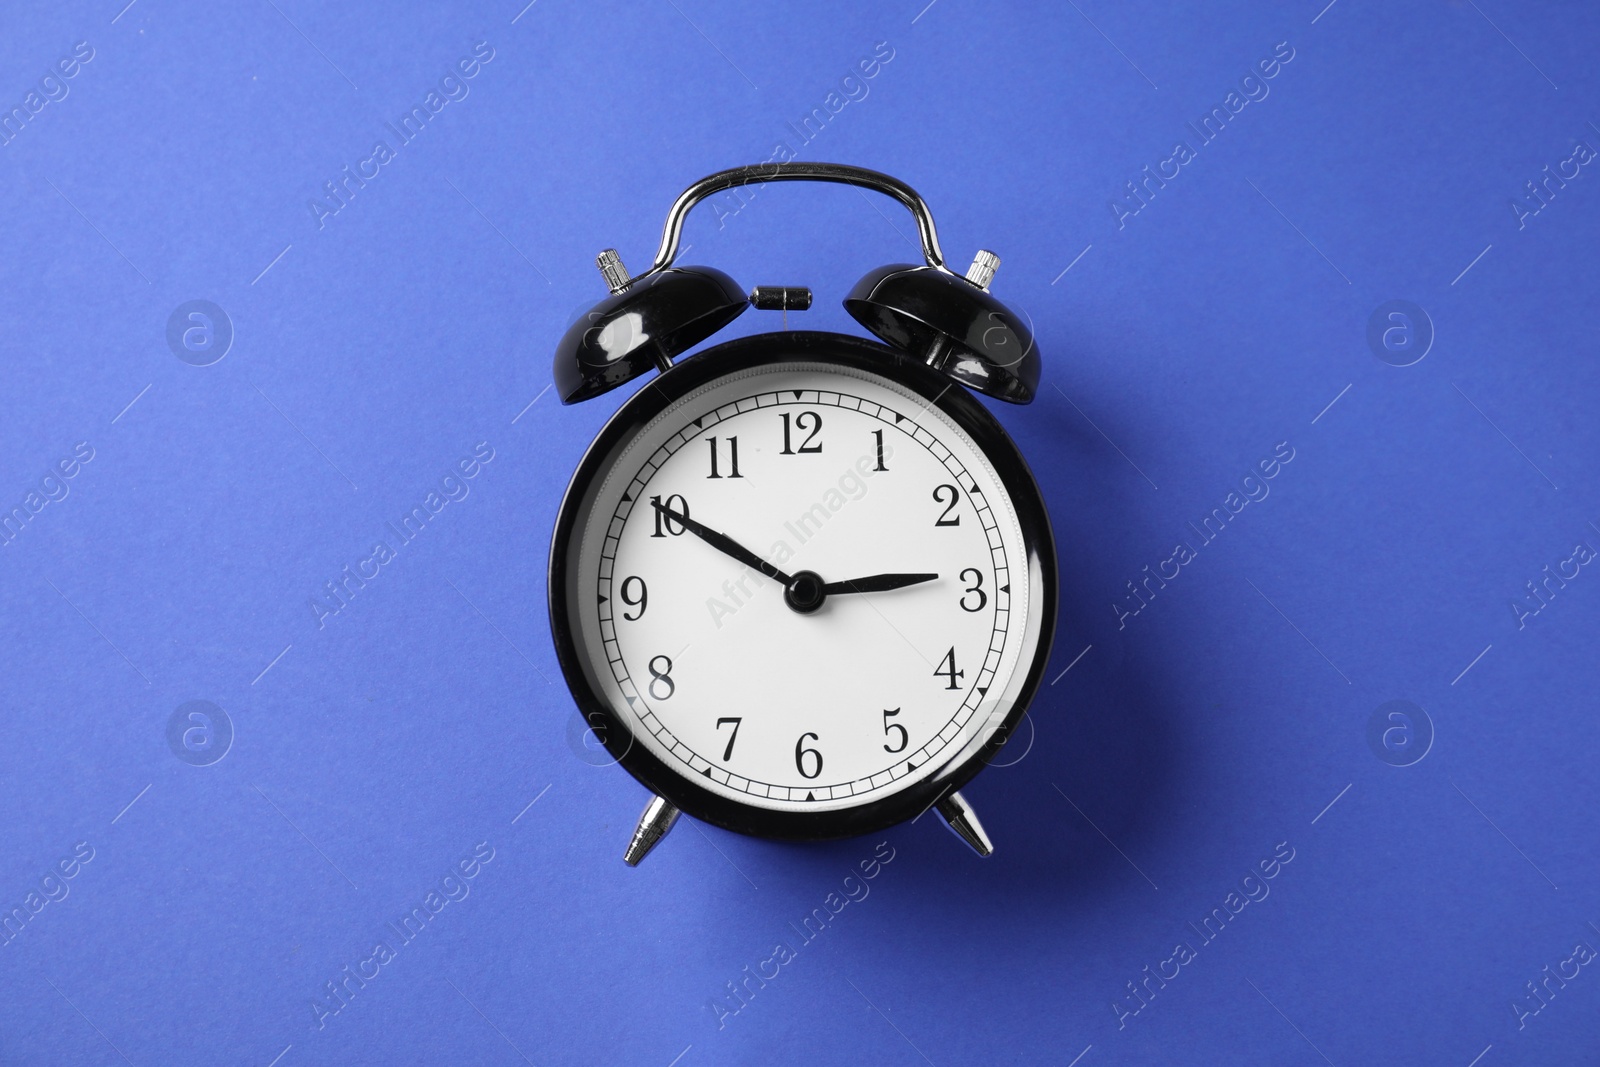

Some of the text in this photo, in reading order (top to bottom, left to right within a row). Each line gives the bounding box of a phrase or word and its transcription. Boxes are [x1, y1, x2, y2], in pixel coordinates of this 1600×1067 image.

[779, 411, 822, 454] 12
[871, 429, 890, 471] 1
[705, 436, 744, 478] 11
[650, 494, 690, 537] 10
[933, 484, 960, 526] 2
[620, 576, 648, 621] 9
[959, 568, 988, 612] 3
[648, 655, 675, 700] 8
[933, 646, 965, 690] 4
[716, 717, 742, 762] 7
[883, 707, 909, 753] 5
[795, 732, 823, 779] 6
